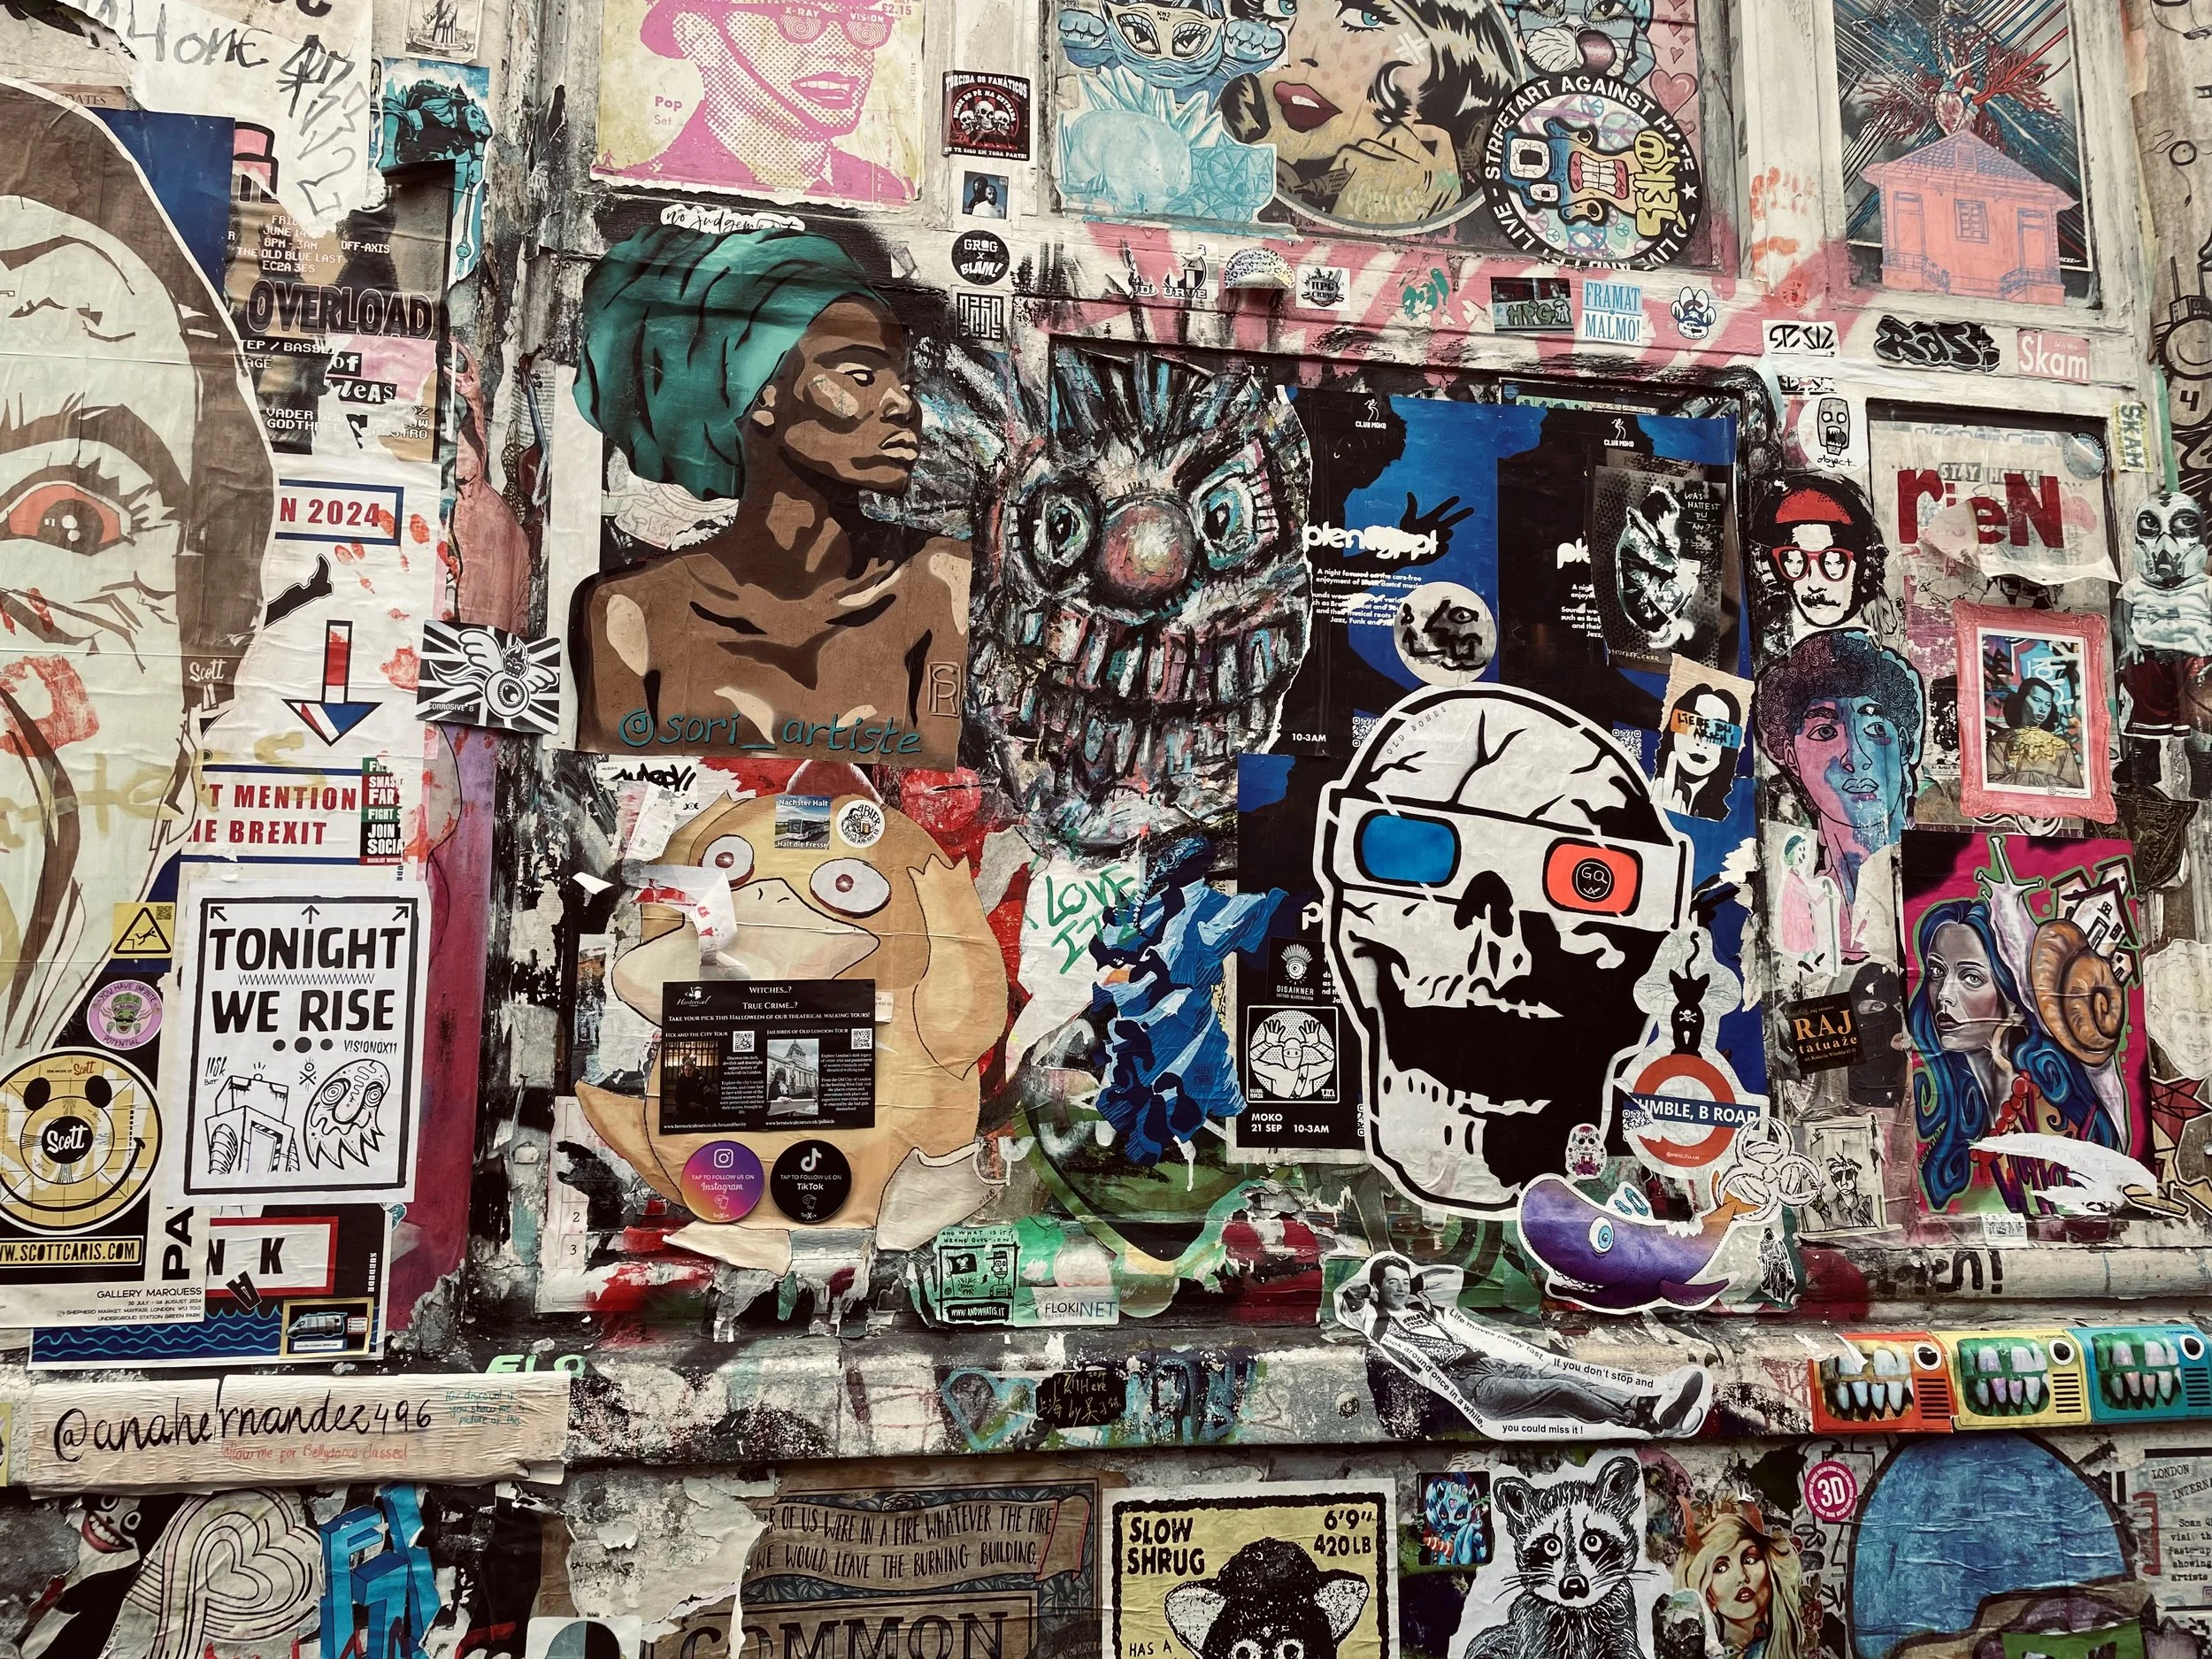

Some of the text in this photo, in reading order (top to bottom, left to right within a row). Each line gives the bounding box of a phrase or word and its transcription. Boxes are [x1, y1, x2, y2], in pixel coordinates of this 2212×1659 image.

[785, 6, 885, 23] X-RAY VISION
[655, 96, 683, 111] Pop
[1561, 75, 1655, 116] AGAINST
[654, 116, 672, 127] Set
[263, 227, 292, 237] JUNE
[264, 238, 318, 250] 8PM 3AM
[341, 241, 391, 254] OFF-AXIS
[237, 246, 343, 265] THE OLD BLUE LAST
[294, 263, 316, 273] 3ES
[960, 260, 1002, 276] BLAM!
[248, 280, 434, 340] OVERLOAD
[1585, 313, 1640, 342] MALMÖ!
[332, 355, 360, 373] of
[2018, 334, 2088, 380] Skam
[266, 408, 314, 419] VADER
[2121, 404, 2144, 469] SKAM
[1938, 463, 1980, 482] STAY
[307, 498, 380, 528] 2024
[189, 658, 227, 682] Scott
[428, 703, 465, 711] CORROSIVE
[618, 706, 923, 756] @sori_artiste
[1291, 732, 1327, 743] 10-3AM
[1386, 706, 1447, 756] OLD BONES
[233, 785, 357, 811] MENTION
[812, 798, 828, 807] Halt
[367, 809, 395, 820] FIGHT
[229, 819, 327, 846] BREXIT
[367, 823, 395, 840] JOIN
[209, 926, 406, 971] TONIGHT
[98, 988, 114, 1001] YOU
[1276, 985, 1315, 995] DISAIKNER
[211, 988, 396, 1034] WE RISE
[1793, 1010, 1852, 1041] RAJ
[1799, 1036, 1857, 1054] tatuaże
[73, 1060, 96, 1076] Scott
[1251, 1113, 1283, 1122] MOKO
[1698, 1105, 1709, 1120] B
[1251, 1124, 1330, 1133] 21 SEP 10-3AM
[46, 1125, 89, 1154] Scott
[701, 1181, 744, 1194] Instagram
[796, 1182, 825, 1191] TikTok
[572, 1211, 580, 1223] 2
[569, 1244, 578, 1256] 3
[96, 1287, 203, 1299] GALLERY MARQUESS
[1448, 1308, 1465, 1325] Life
[1465, 1320, 1496, 1339] moves
[1496, 1333, 1525, 1349] pretty
[1553, 1356, 1655, 1389] If you don't stop and
[1402, 1345, 1432, 1374] around
[1430, 1371, 1450, 1392] once
[1448, 1386, 1459, 1401] in
[1463, 1402, 1486, 1428] while,
[53, 1388, 434, 1464] @anahernandez496
[1502, 1423, 1579, 1435] you could miss it
[2151, 1463, 2191, 1481] LONDON
[1816, 1476, 1847, 1508] 3D
[781, 1504, 1056, 1548] OF US WERE IN A FIRE, WHATEVER THE FIRE
[1128, 1516, 1194, 1546] SLOW
[2178, 1517, 2202, 1528] Scan
[756, 1540, 1038, 1580] WE WOULD LEAVE THE BURNING BUILDING.
[1126, 1546, 1206, 1578] SHRUG
[2170, 1572, 2209, 1583] artists
[1129, 1640, 1173, 1658] HAS A
